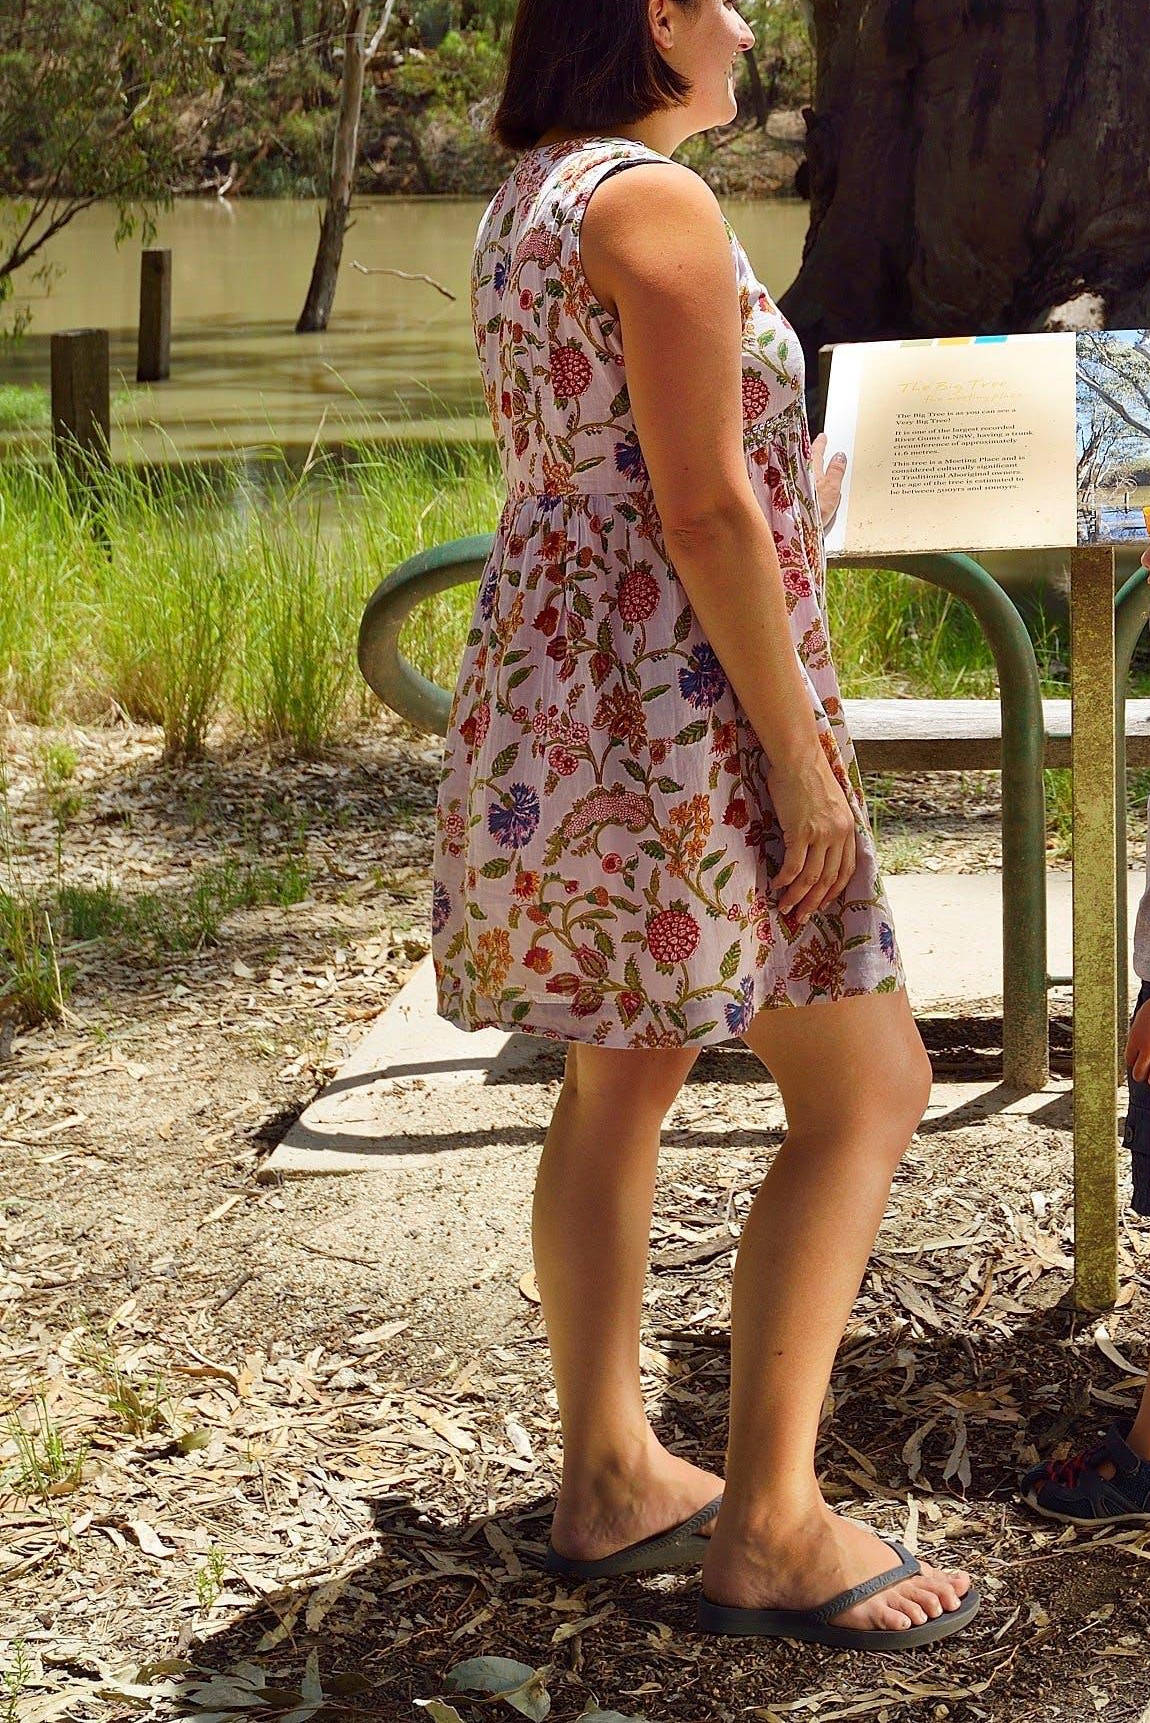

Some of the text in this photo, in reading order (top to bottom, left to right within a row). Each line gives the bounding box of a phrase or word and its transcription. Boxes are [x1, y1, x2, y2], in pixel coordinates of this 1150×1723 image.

[897, 379, 1008, 395] The Big Tree
[961, 438, 1018, 447] approximately
[937, 464, 974, 472] culturally
[976, 463, 1018, 471] significant
[901, 472, 946, 481] Traditional
[948, 470, 990, 478] Aboriginal
[974, 476, 1014, 484] estimated
[902, 487, 935, 495] between
